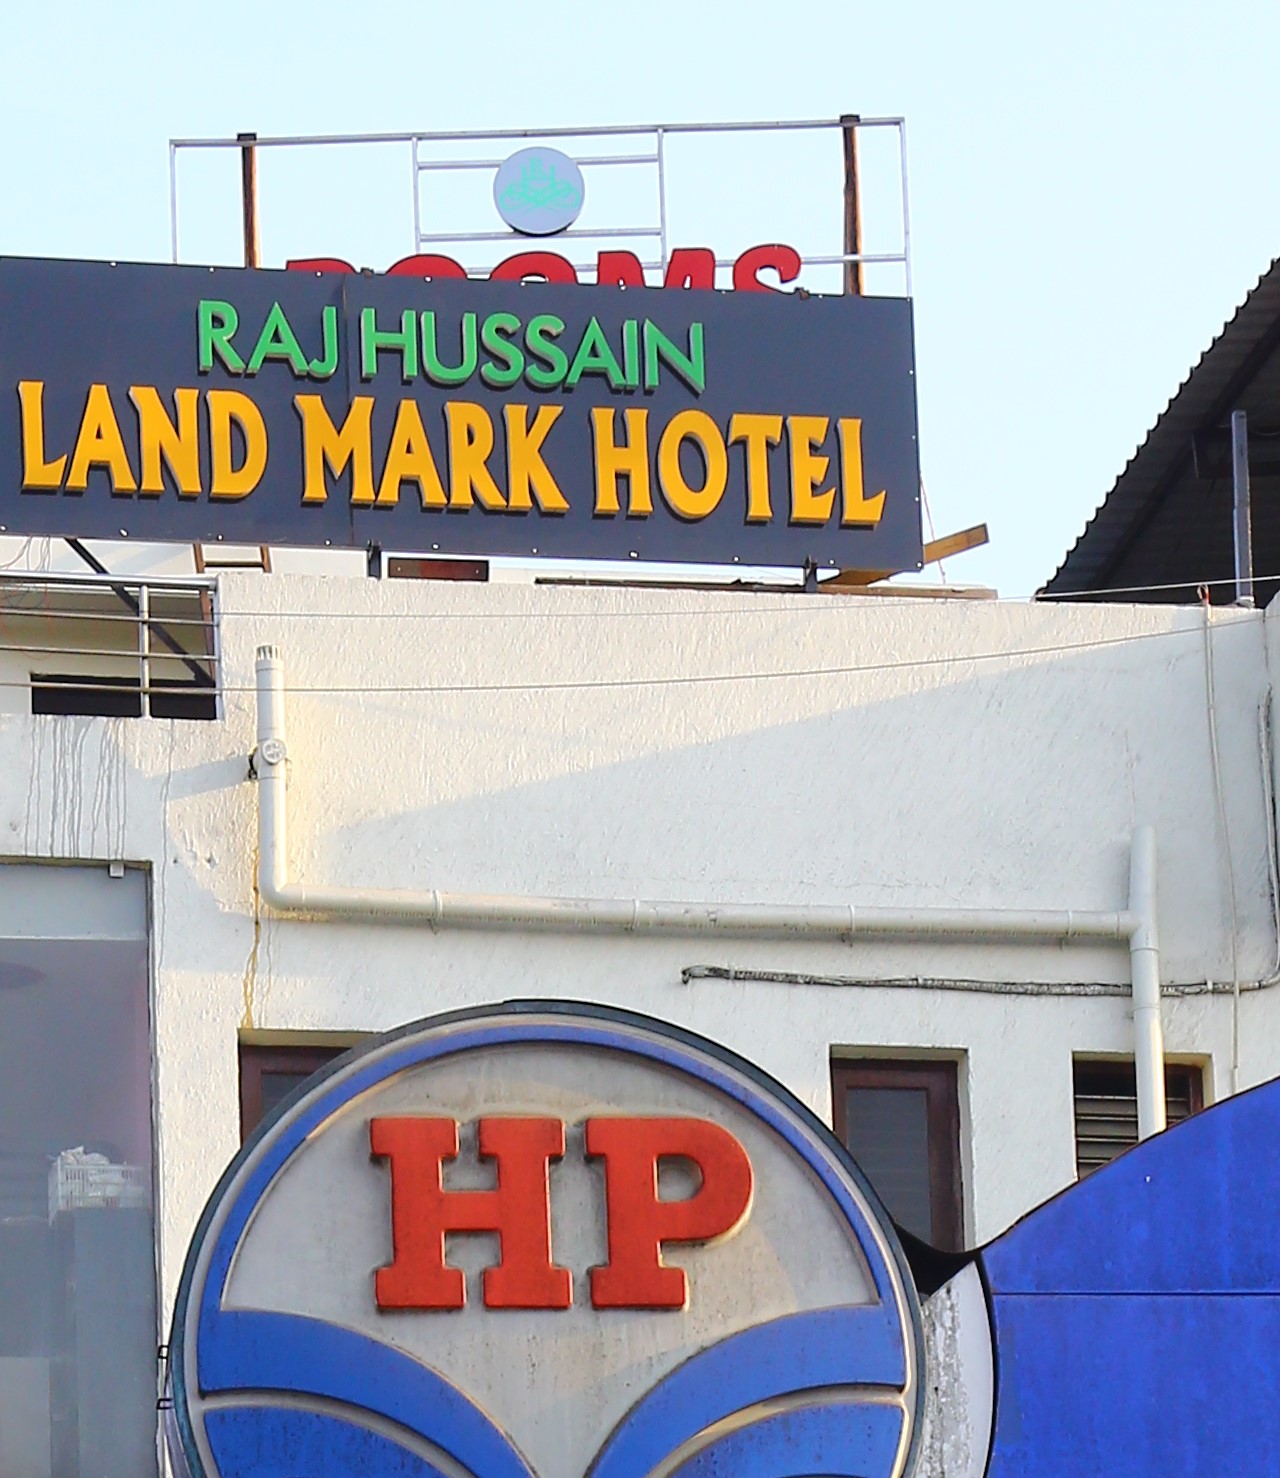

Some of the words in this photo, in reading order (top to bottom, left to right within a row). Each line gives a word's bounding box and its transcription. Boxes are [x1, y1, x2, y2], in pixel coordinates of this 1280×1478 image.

[197, 299, 339, 378] RAJ
[361, 307, 706, 396] HUSSAIN
[18, 380, 269, 499] LAND
[294, 393, 570, 513] MARK
[590, 405, 887, 525] HOTEL
[368, 1115, 754, 1311] HP
